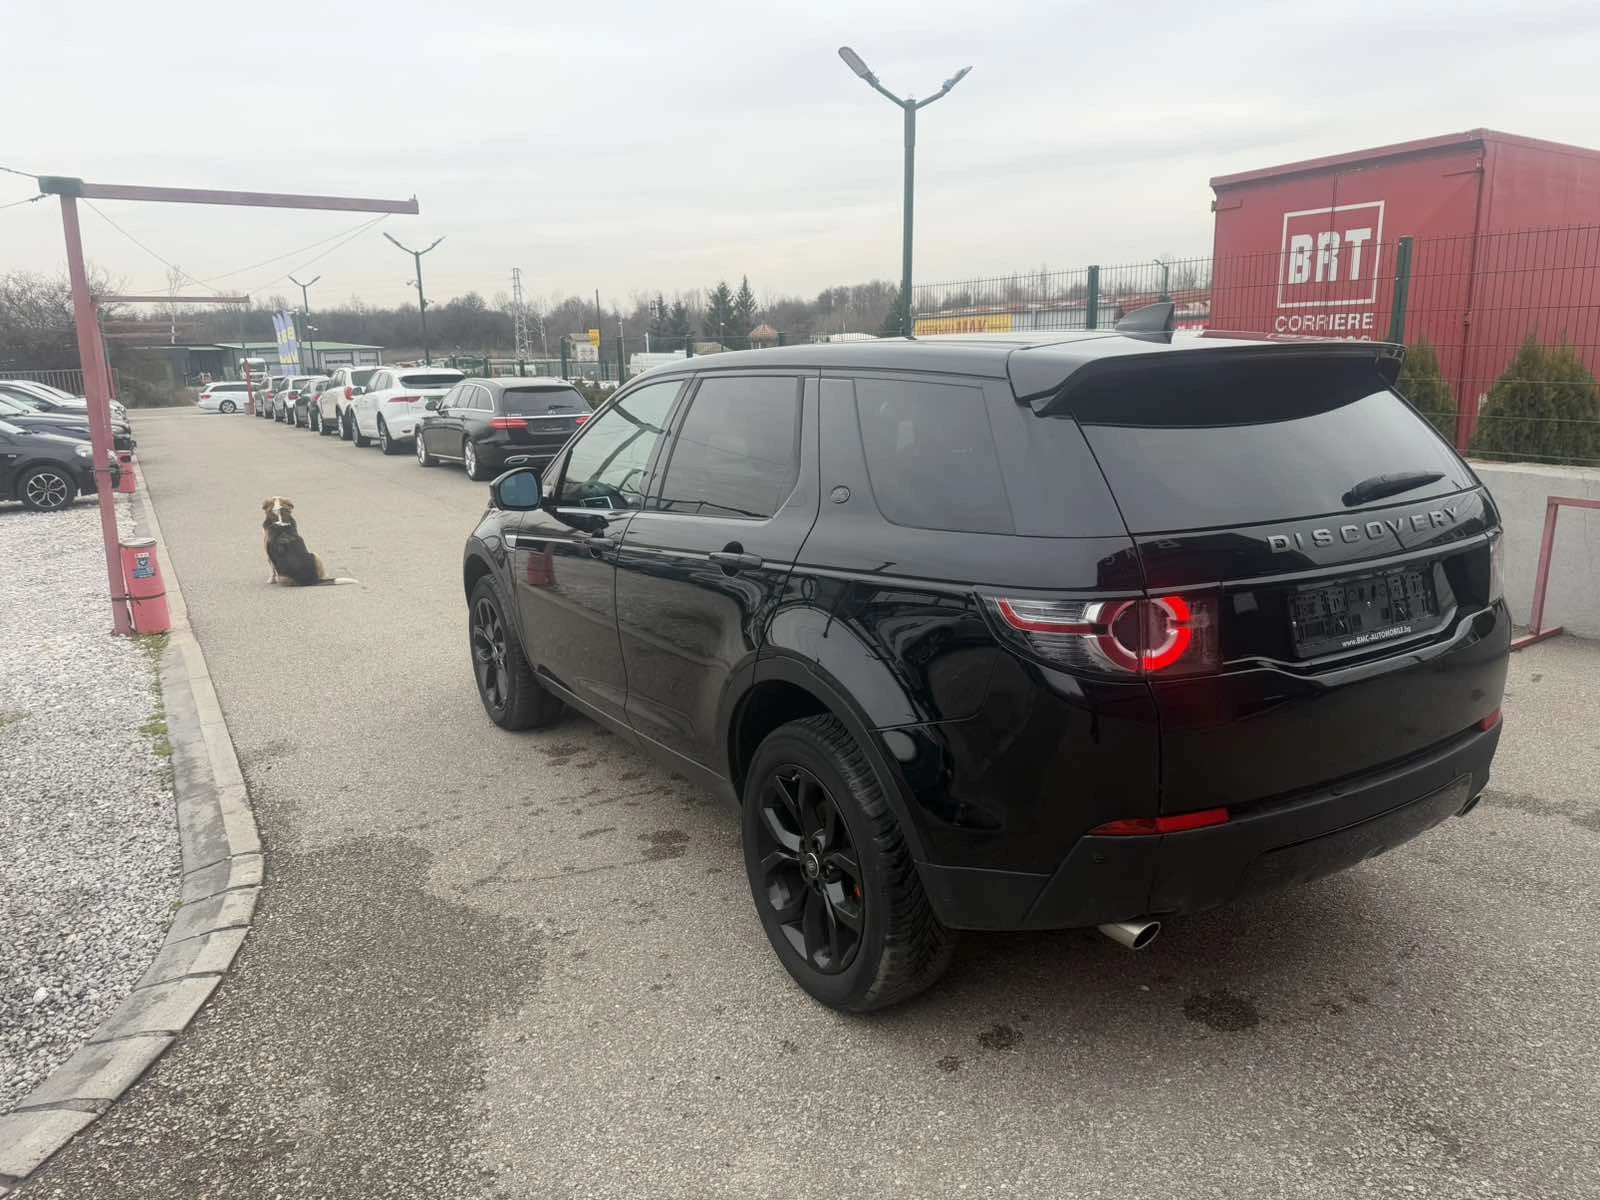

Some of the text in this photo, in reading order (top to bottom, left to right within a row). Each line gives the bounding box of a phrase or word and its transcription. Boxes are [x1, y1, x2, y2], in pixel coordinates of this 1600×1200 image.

[1288, 229, 1371, 284] BRT
[1275, 313, 1374, 332] CORRIERE
[1267, 506, 1458, 553] DISCOVERY
